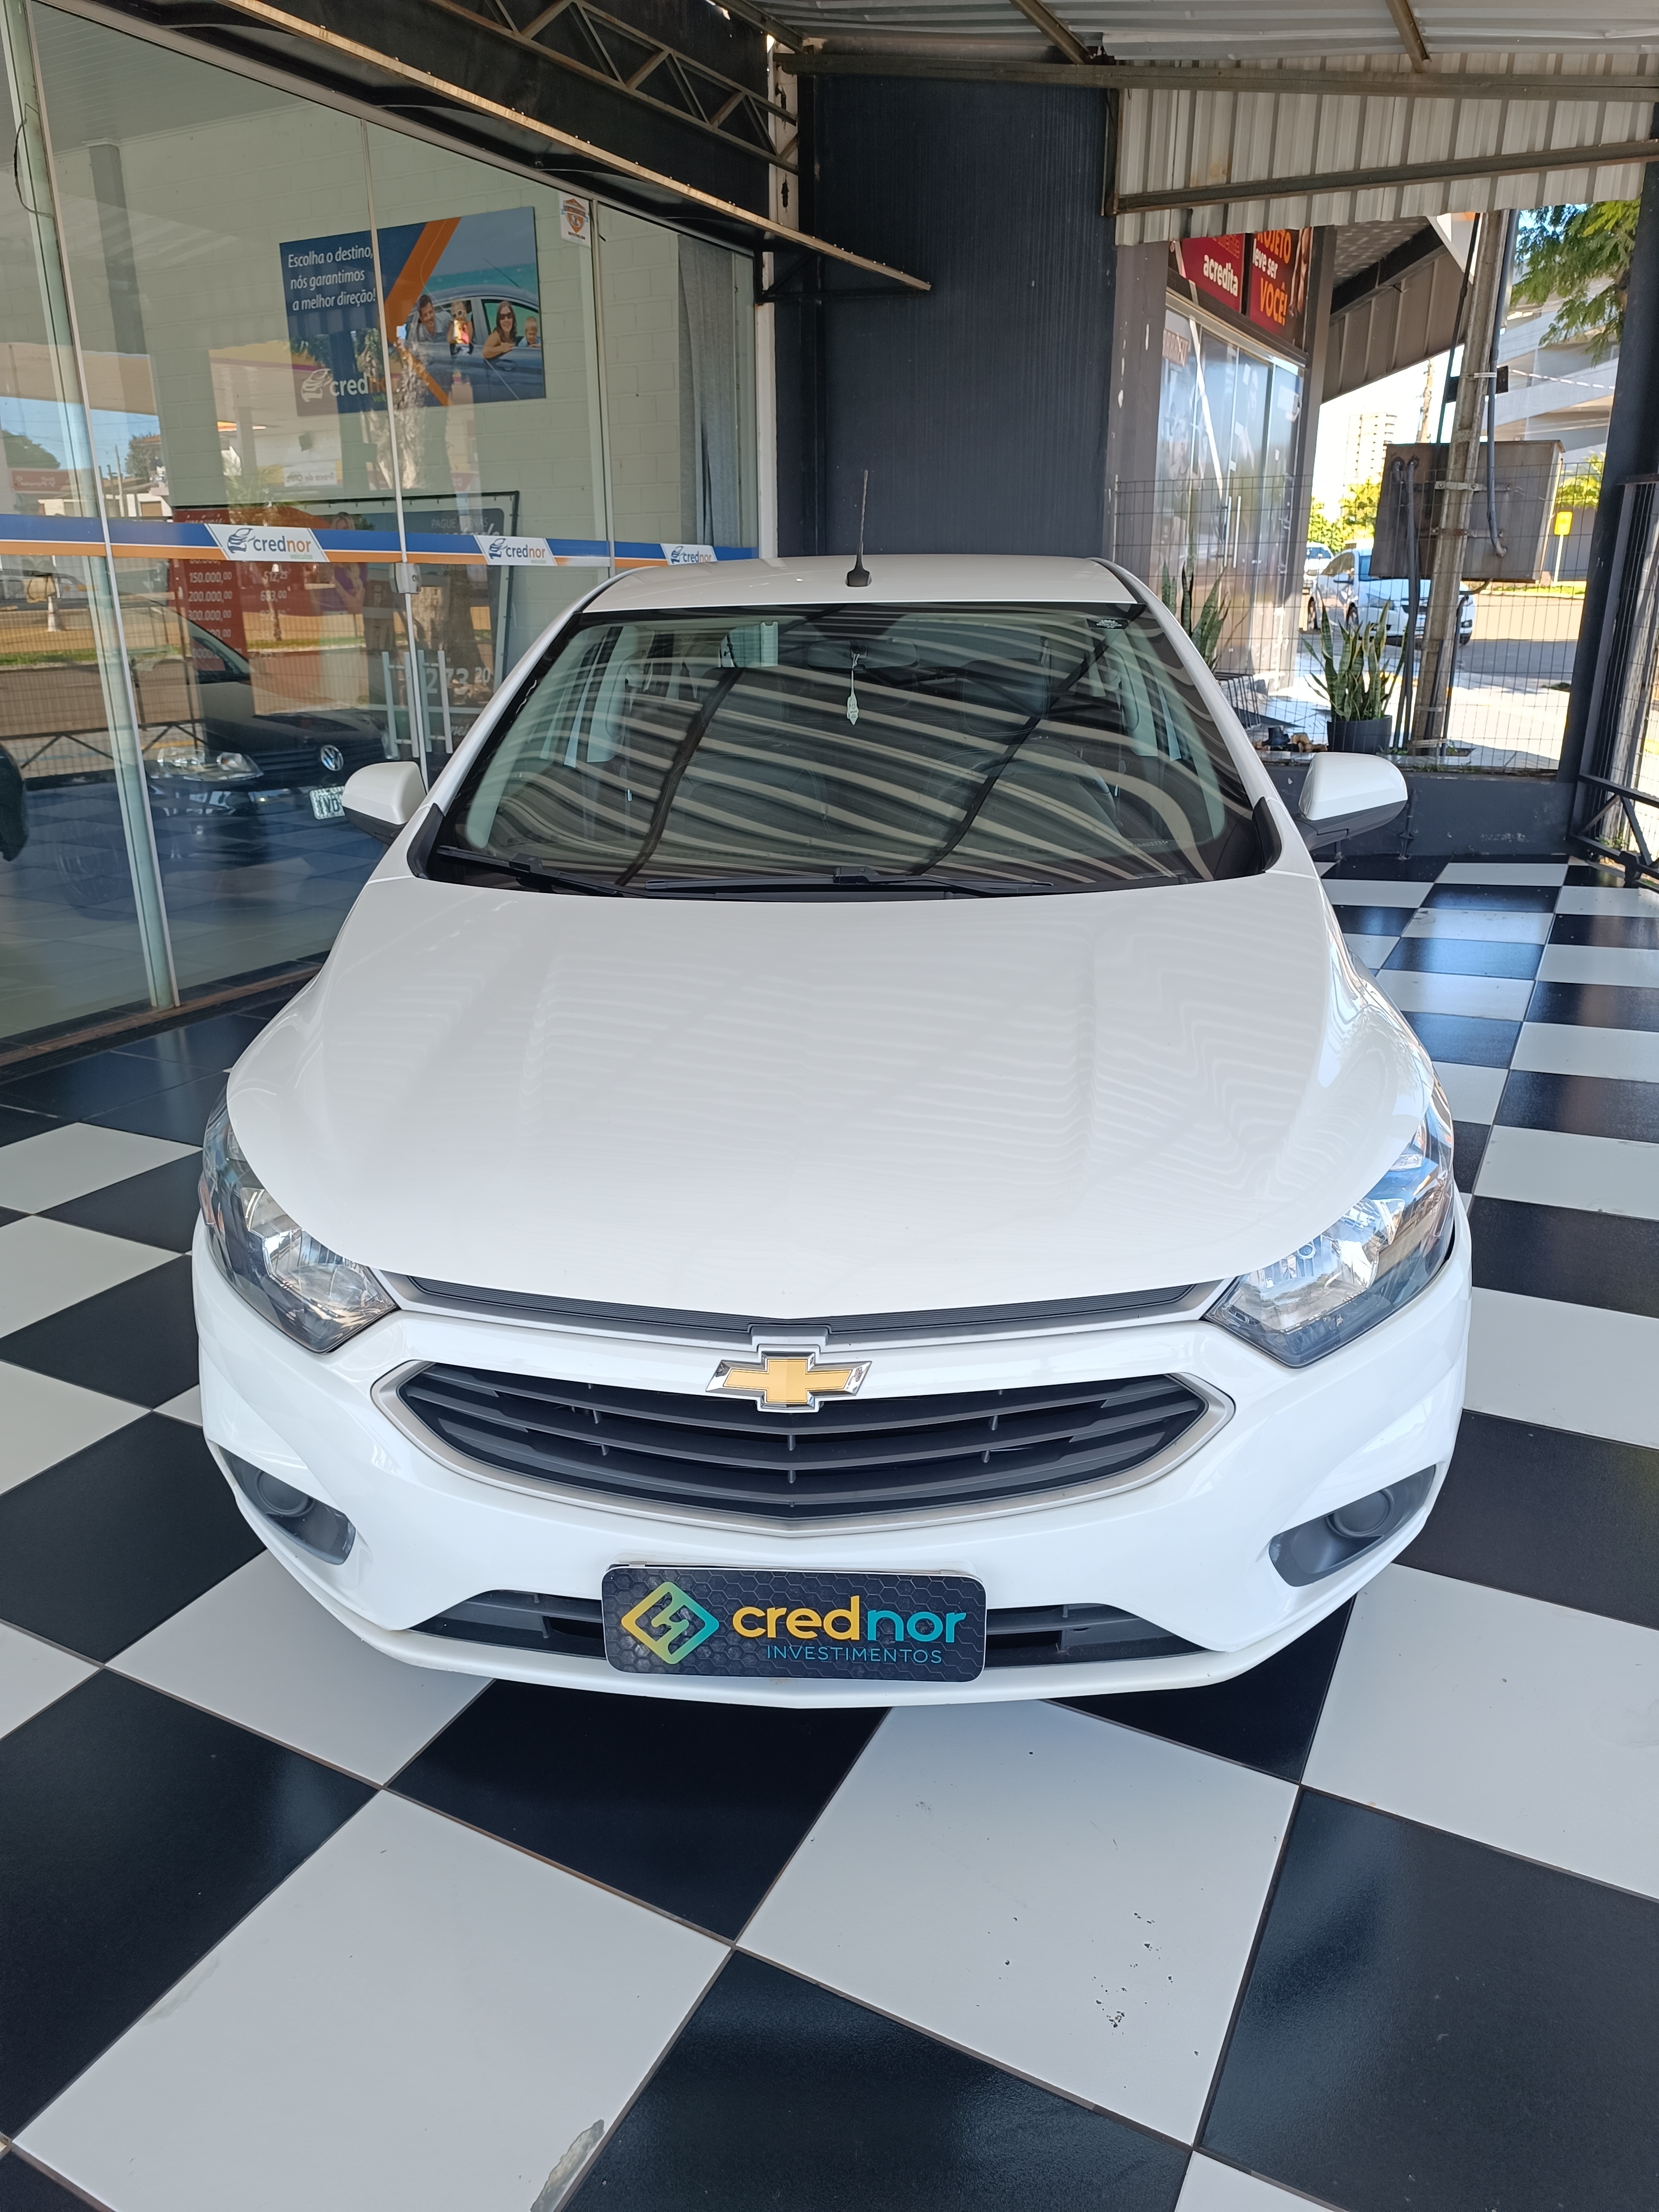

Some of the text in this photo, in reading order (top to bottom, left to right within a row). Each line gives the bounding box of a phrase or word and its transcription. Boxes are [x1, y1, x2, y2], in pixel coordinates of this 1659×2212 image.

[288, 245, 374, 268] Escolha o destino,
[290, 269, 365, 291] nós garantimos
[1203, 254, 1238, 297] acredita
[1267, 258, 1278, 280] ser
[292, 288, 376, 311] a melhor direção!
[1260, 277, 1288, 326] VOCÊ!
[431, 518, 457, 529] PAGUE
[253, 536, 311, 552] crednor
[506, 545, 546, 558] crednor
[683, 551, 712, 563] crednor
[188, 590, 233, 604] 200.000,00
[732, 1595, 967, 1643] crednor
[767, 1645, 943, 1664] INVESTIMENTOS
